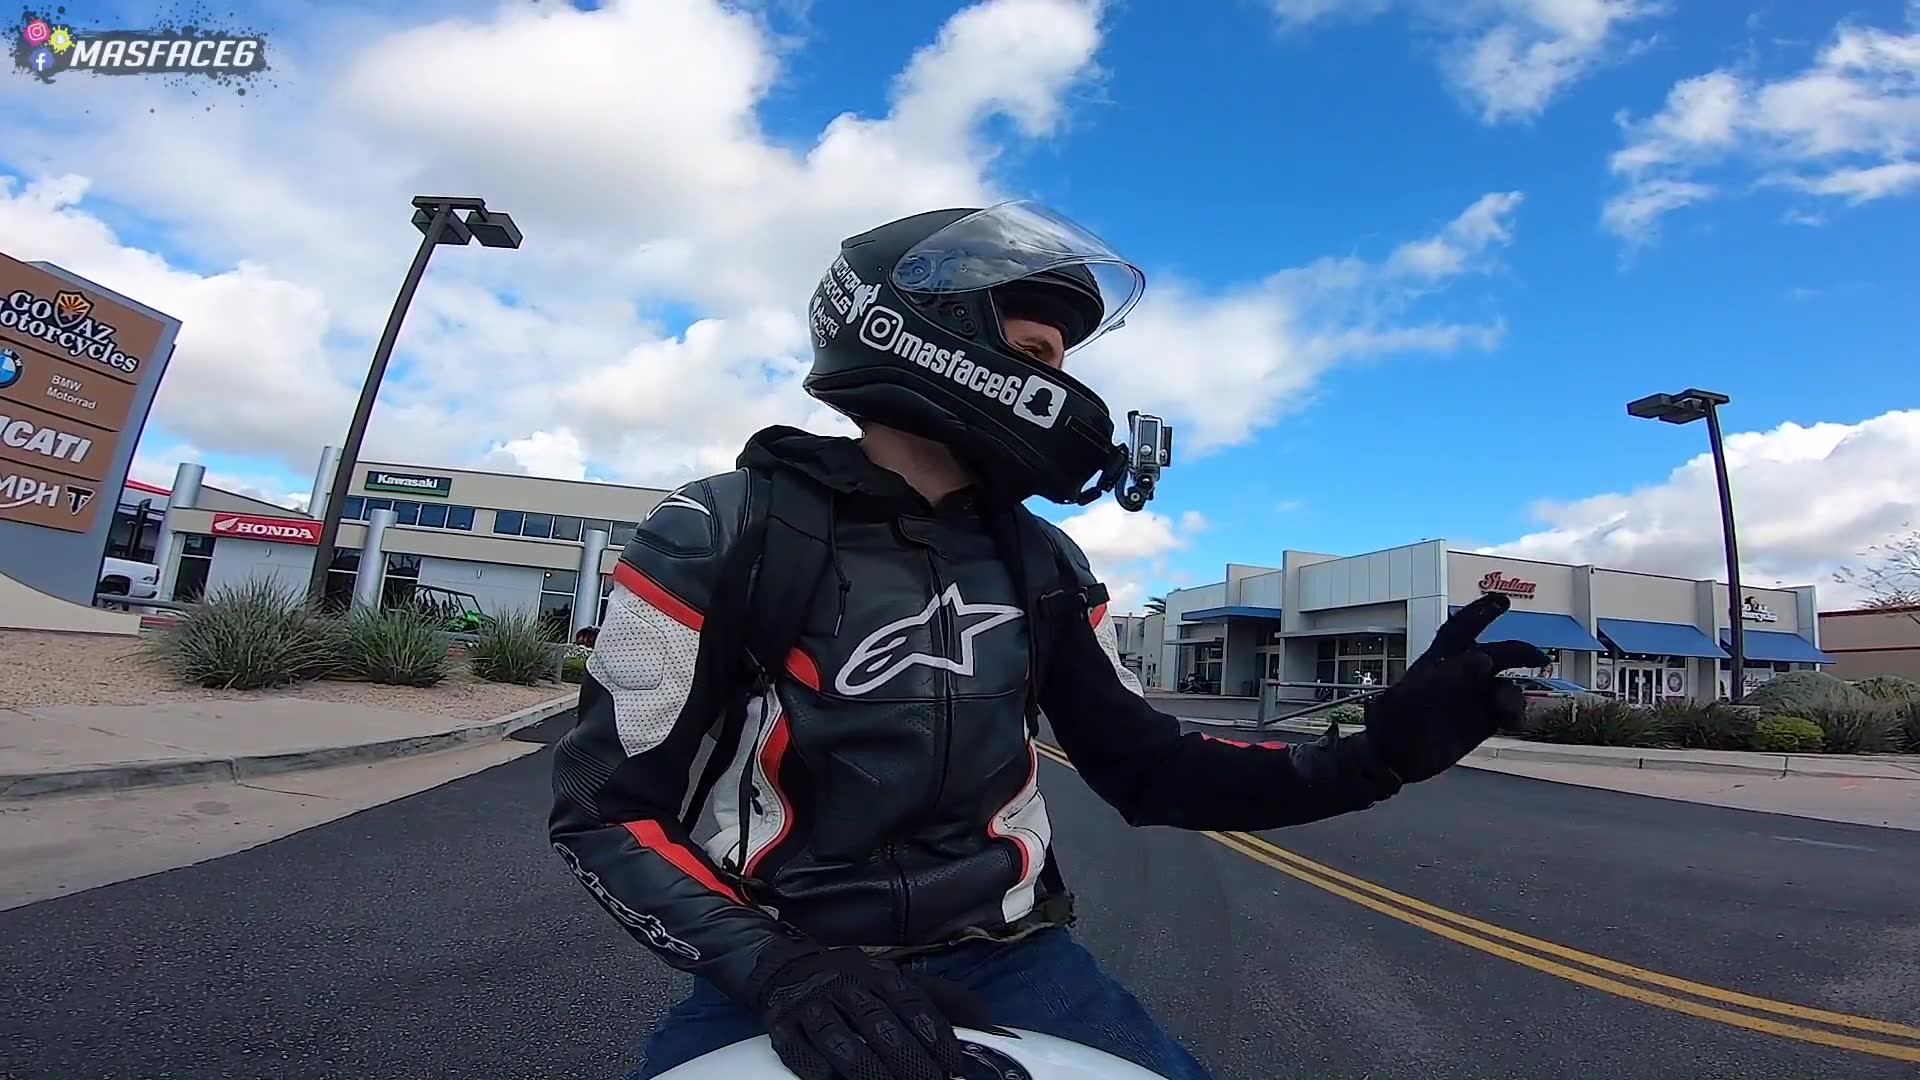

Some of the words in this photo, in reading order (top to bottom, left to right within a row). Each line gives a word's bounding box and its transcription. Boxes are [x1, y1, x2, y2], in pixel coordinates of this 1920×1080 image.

[9, 291, 52, 319] GO
[73, 318, 116, 344] AZ
[0, 302, 138, 372] otorcycles
[893, 332, 1022, 406] masface6
[51, 374, 82, 391] BMW
[46, 387, 97, 409] Motorrad
[377, 474, 438, 488] Kawasaki
[236, 523, 314, 539] HONDA
